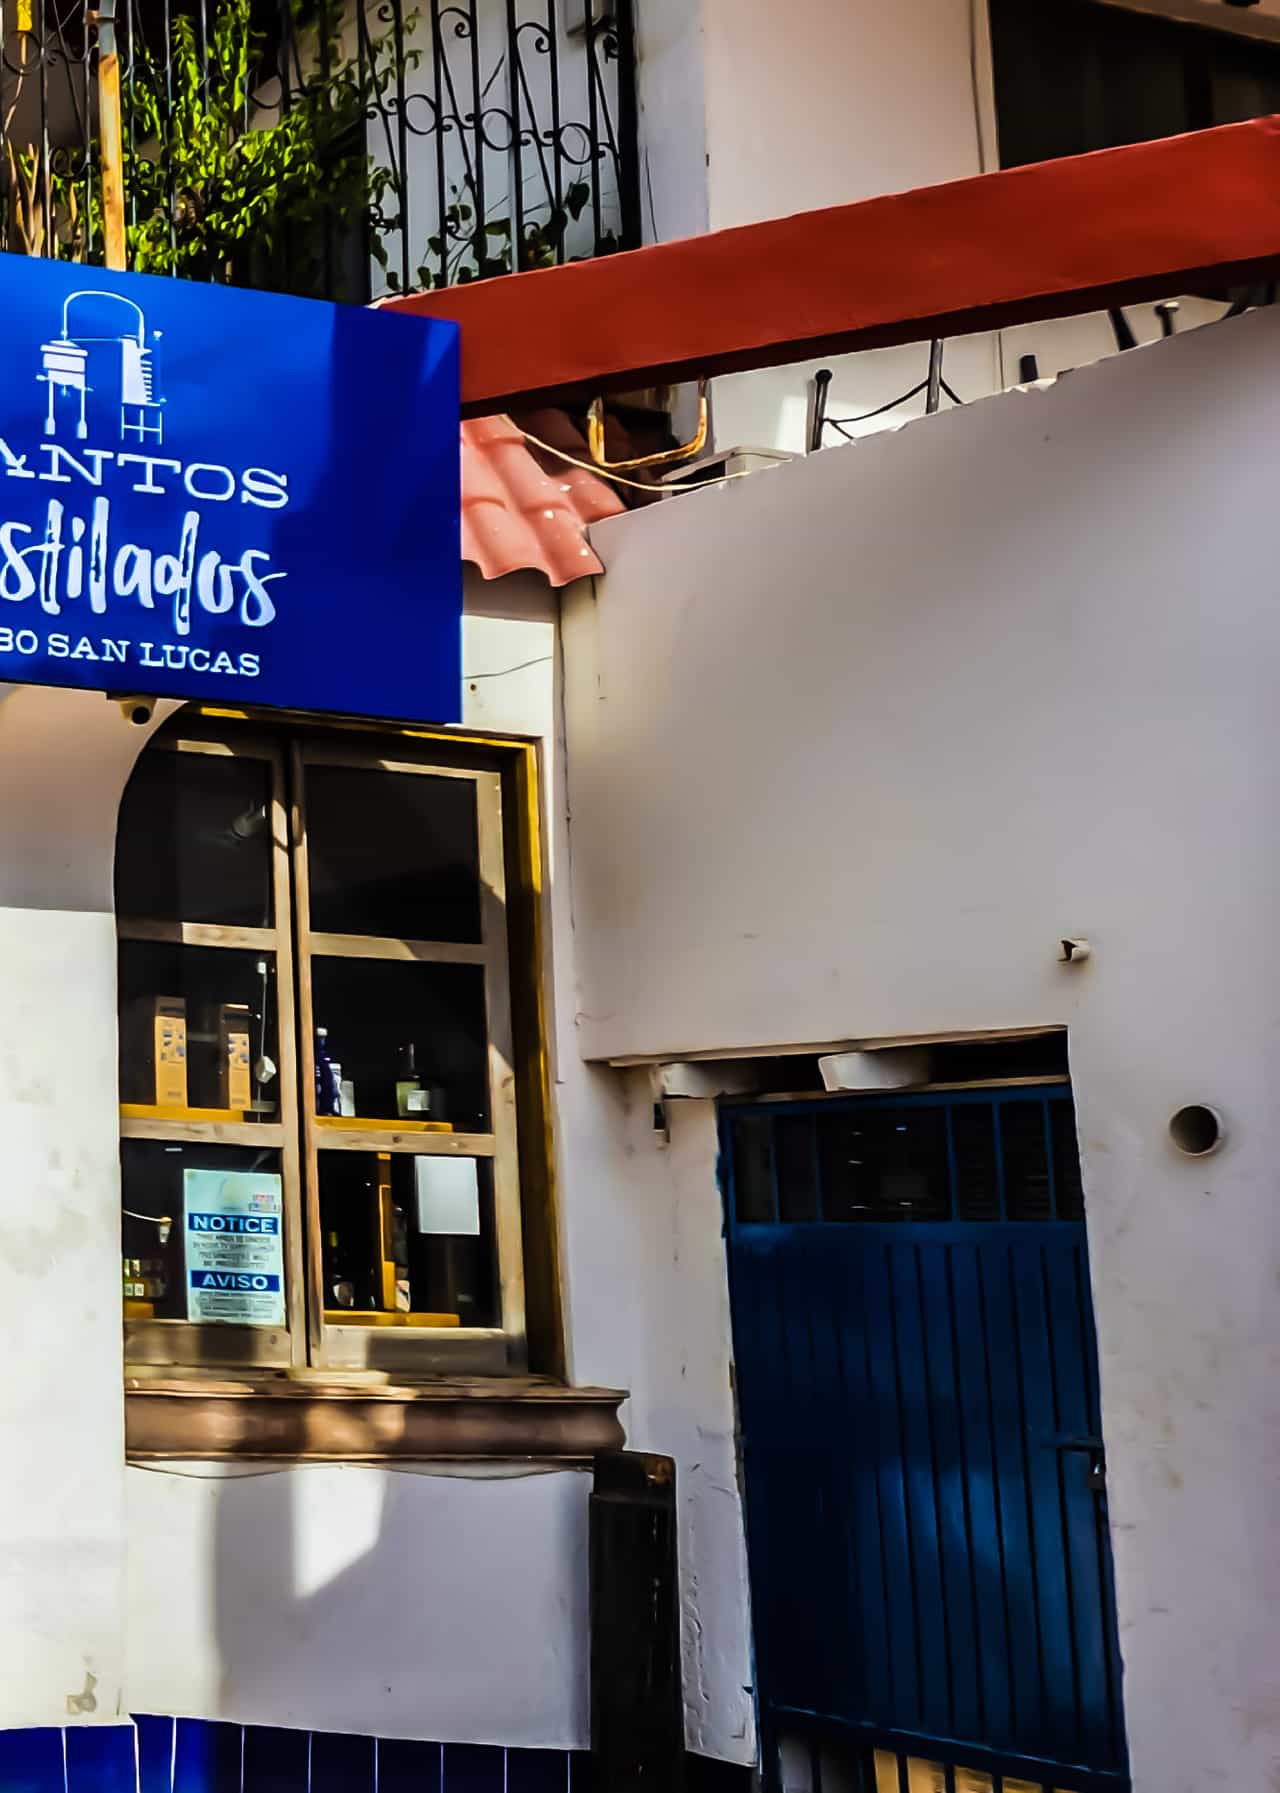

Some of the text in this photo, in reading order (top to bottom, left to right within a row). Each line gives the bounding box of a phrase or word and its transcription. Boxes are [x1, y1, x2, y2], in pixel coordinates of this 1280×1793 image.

[47, 632, 130, 664] SAN
[139, 641, 260, 677] LUCAS
[193, 1215, 275, 1233] NOTICE
[202, 1272, 268, 1291] AVISO
